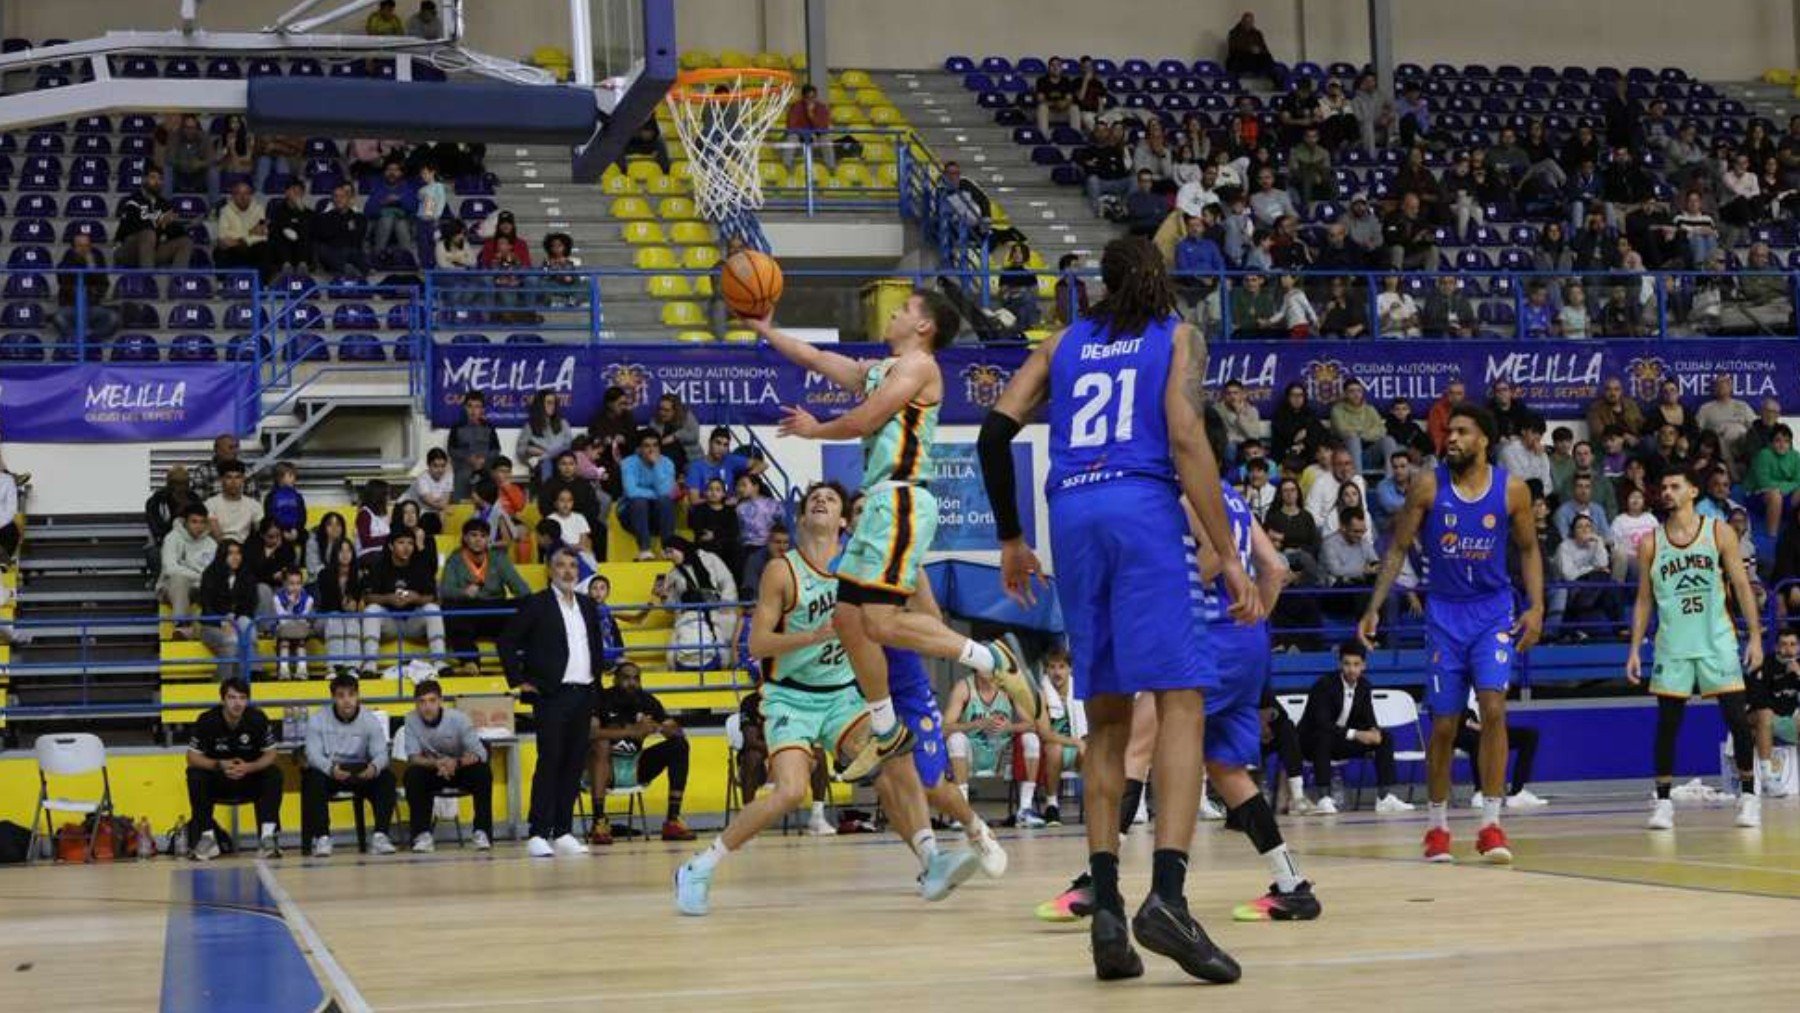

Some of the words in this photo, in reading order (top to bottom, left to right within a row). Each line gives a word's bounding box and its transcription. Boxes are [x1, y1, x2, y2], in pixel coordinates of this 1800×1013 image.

[443, 355, 576, 391] MELILLA
[657, 366, 702, 379] CIUDAD
[706, 365, 778, 379] AUTÓNOMA
[1202, 353, 1278, 386] LILLA
[1352, 363, 1394, 375] CIUDAD
[1484, 352, 1603, 384] MELILLA
[84, 381, 186, 410] MELILLA
[662, 380, 780, 404] MELILLA
[1356, 376, 1454, 400] MELILL
[1677, 374, 1779, 397] MELLA
[1069, 368, 1138, 448] 21
[935, 464, 976, 478] LILLA
[938, 512, 964, 525] oda
[968, 511, 994, 525] Orti
[1661, 554, 1714, 581] PALMER
[808, 591, 837, 623] PAL
[1681, 596, 1704, 615] 25
[818, 643, 847, 666] 22
